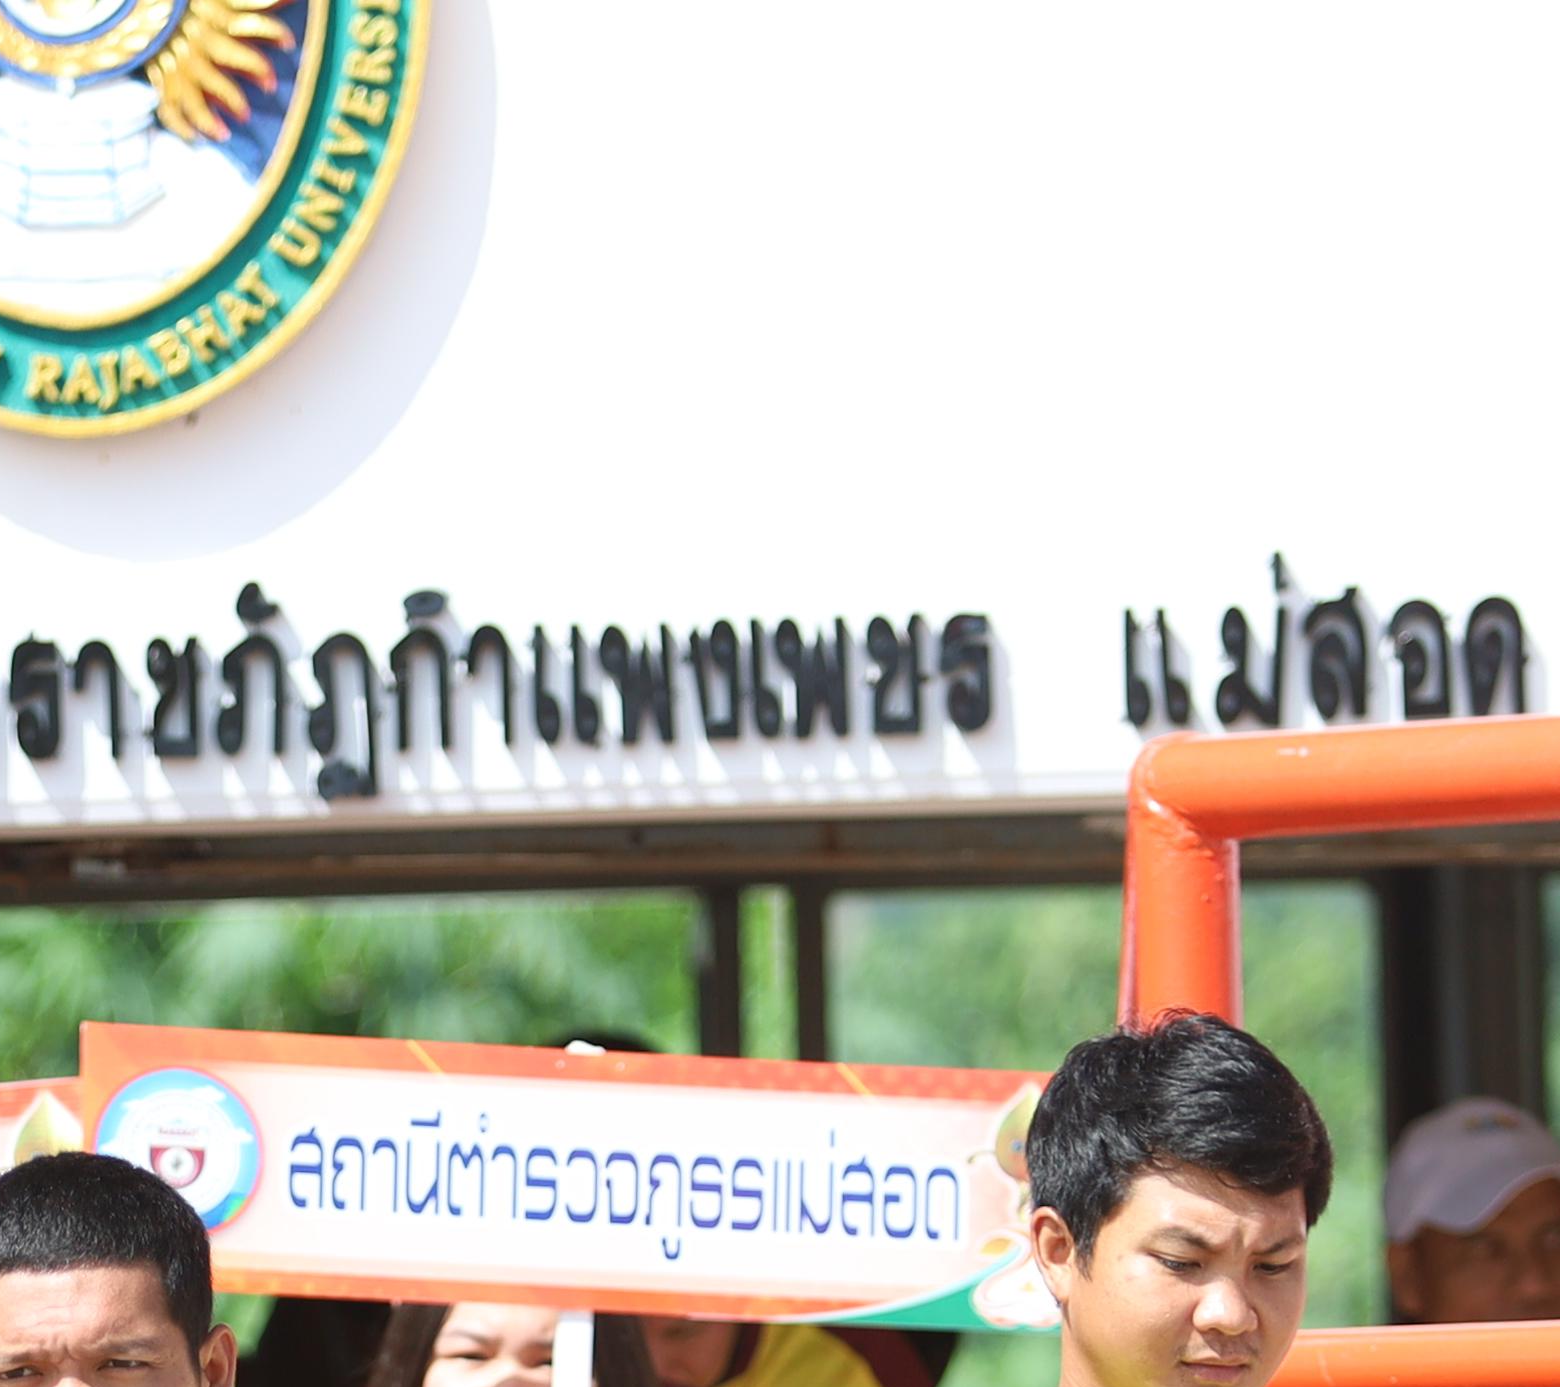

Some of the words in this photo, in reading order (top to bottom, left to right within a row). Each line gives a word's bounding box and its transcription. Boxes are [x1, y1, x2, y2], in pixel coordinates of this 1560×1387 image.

[24, 261, 278, 410] RAJABHAT
[1124, 551, 1525, 728] แม่สอด
[289, 1110, 960, 1261] สถานีตำรวจภูธรแม่สอด
